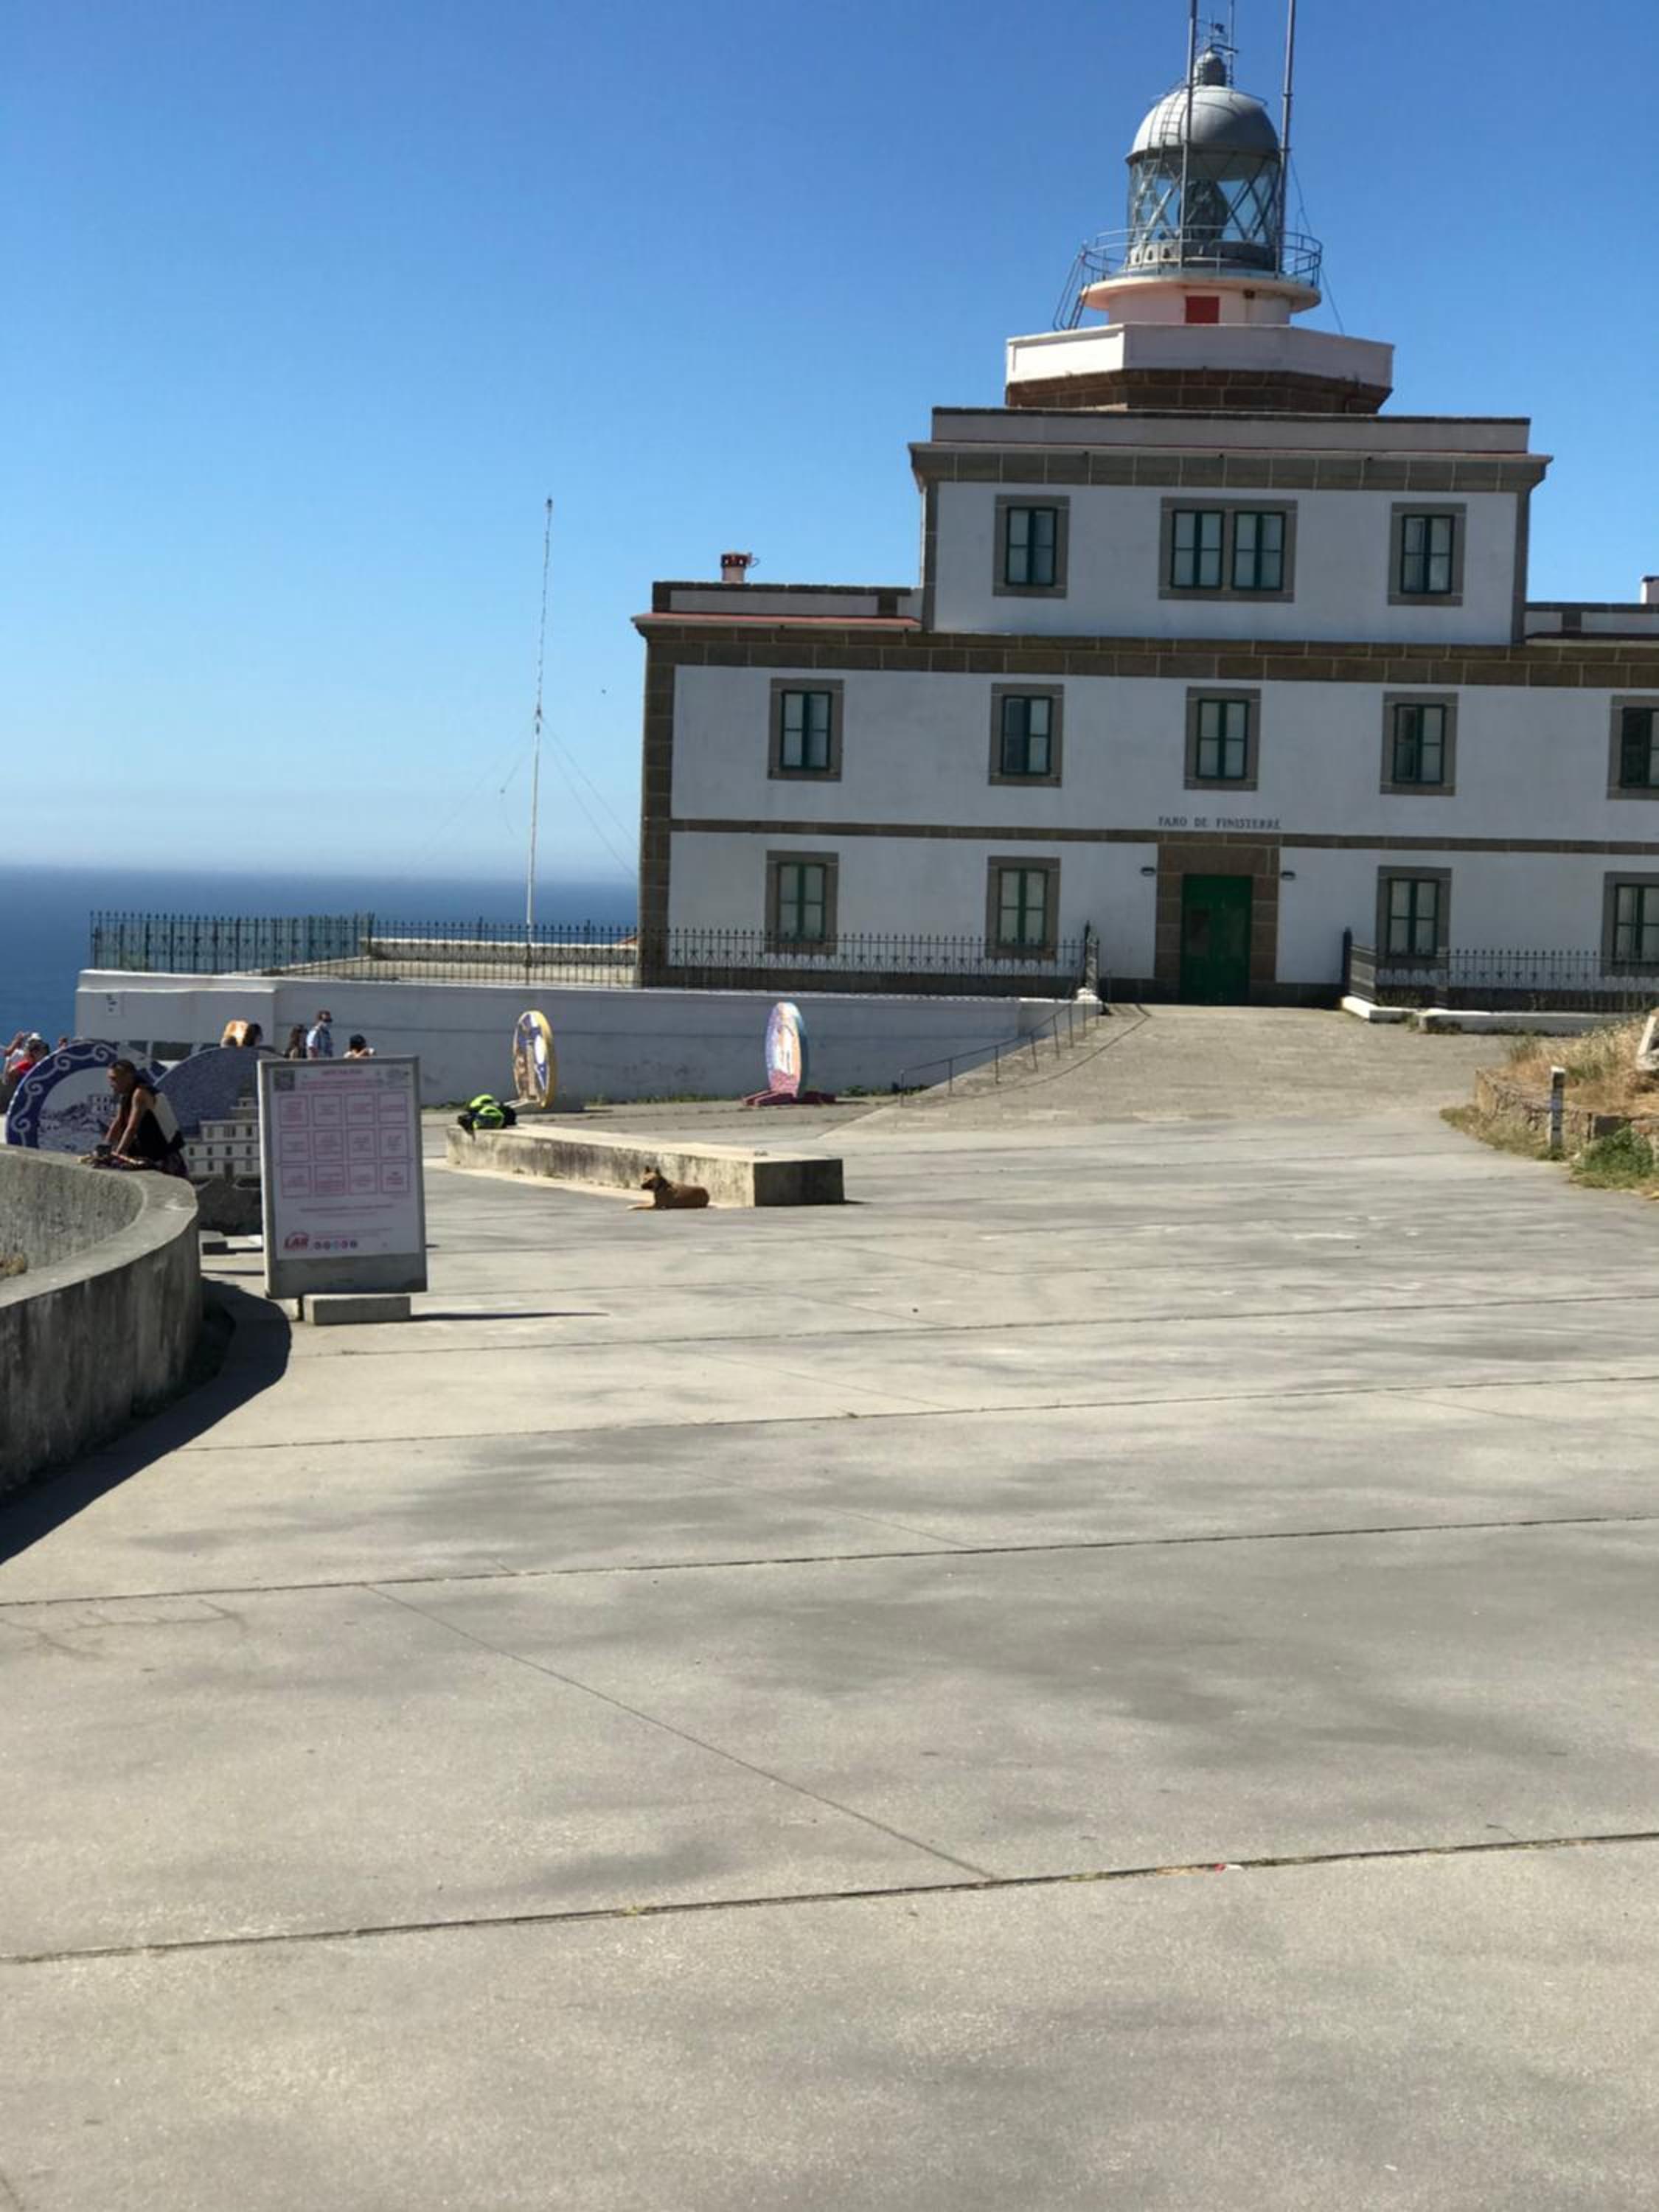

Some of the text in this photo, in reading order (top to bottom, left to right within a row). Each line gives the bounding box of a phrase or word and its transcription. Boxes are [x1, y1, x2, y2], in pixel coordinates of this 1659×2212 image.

[1158, 815, 1281, 830] FARO DE FINISTERRE
